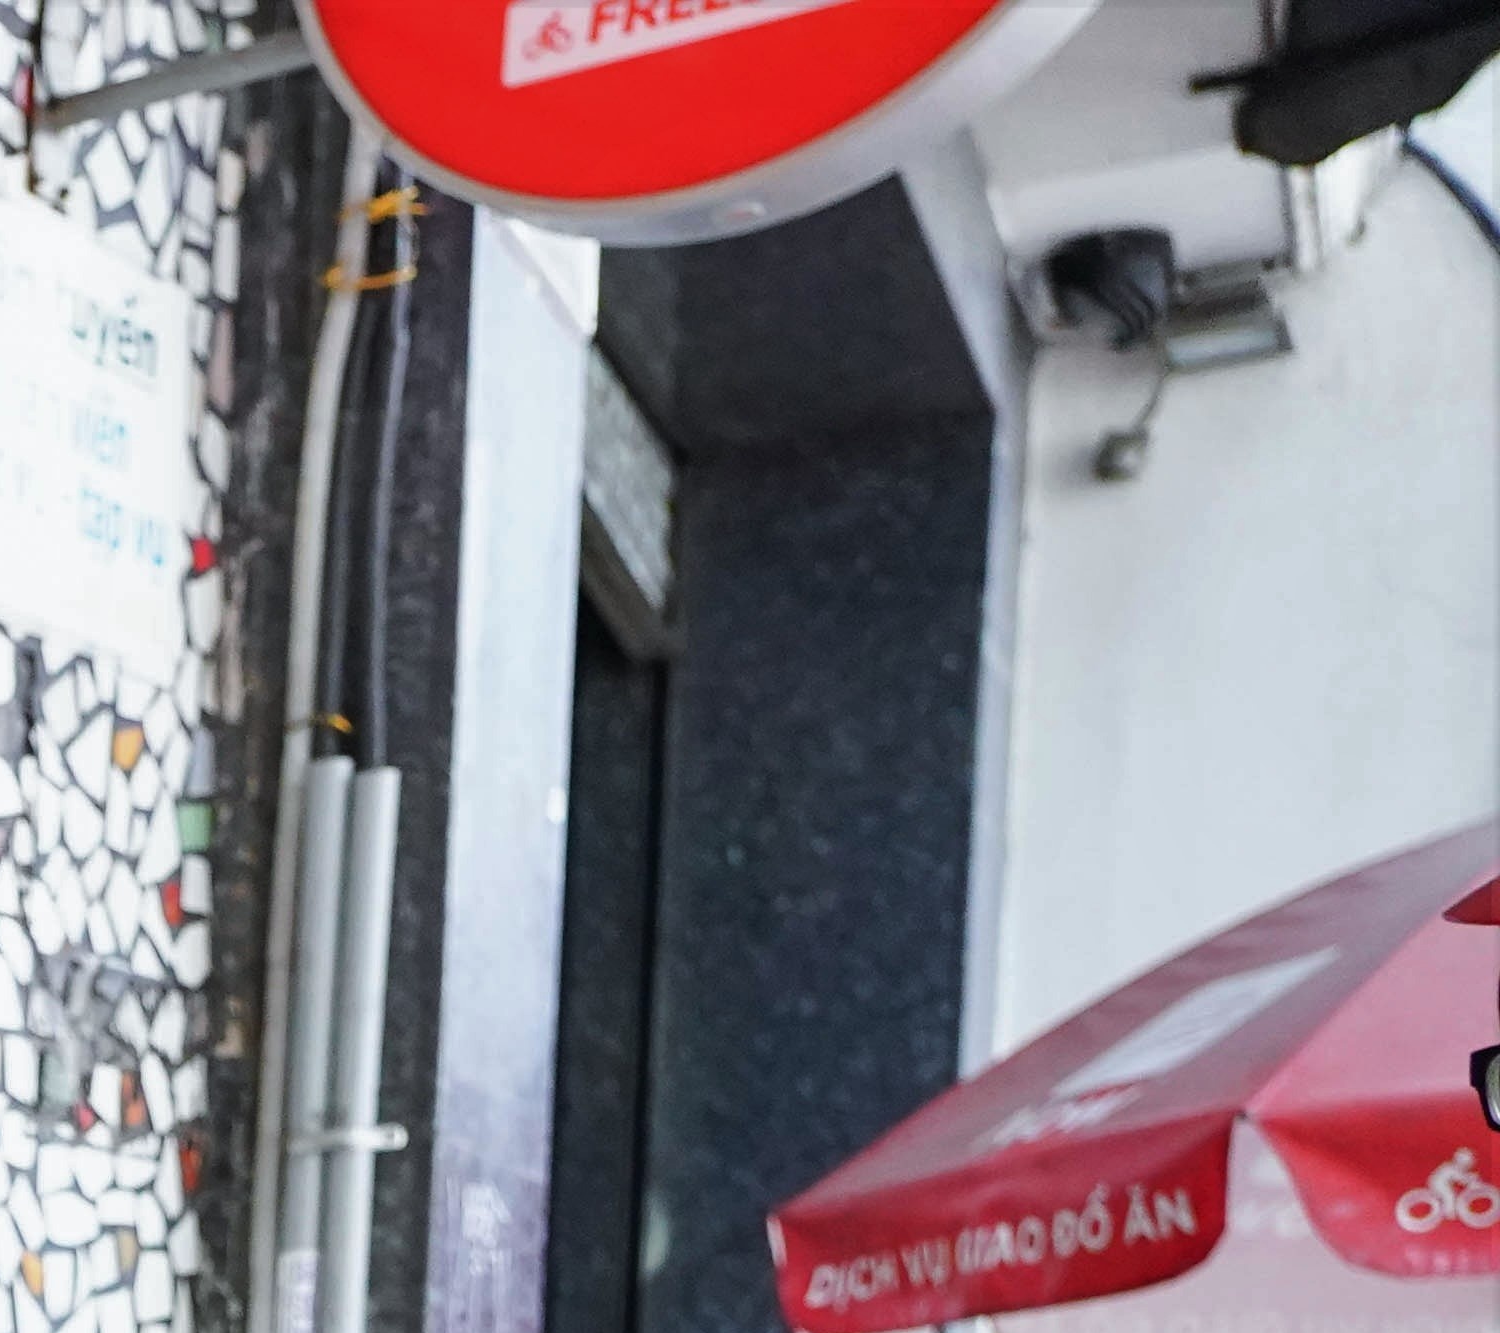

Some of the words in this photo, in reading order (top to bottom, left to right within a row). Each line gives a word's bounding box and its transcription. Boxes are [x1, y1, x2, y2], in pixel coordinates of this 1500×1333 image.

[804, 1254, 897, 1314] DỊCH
[955, 1215, 1047, 1275] GIAO
[1124, 1182, 1197, 1246] ĂN
